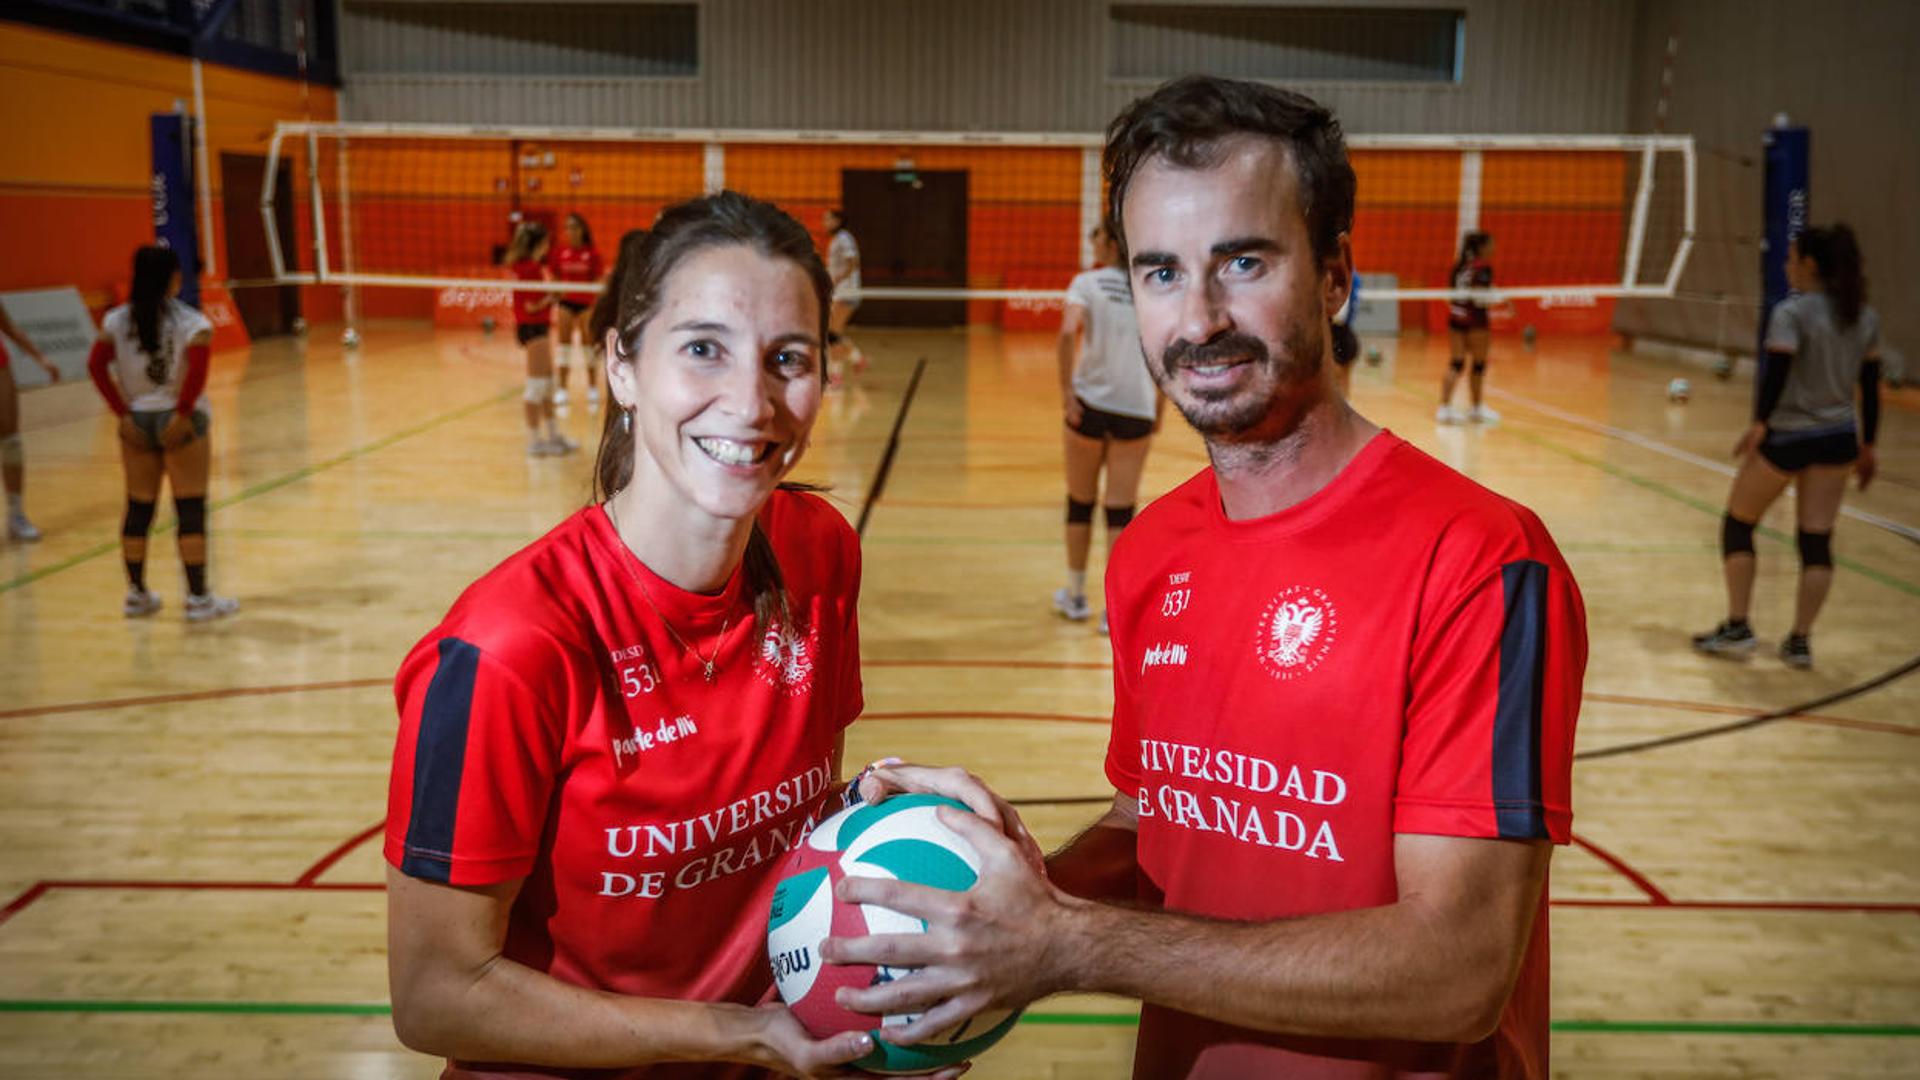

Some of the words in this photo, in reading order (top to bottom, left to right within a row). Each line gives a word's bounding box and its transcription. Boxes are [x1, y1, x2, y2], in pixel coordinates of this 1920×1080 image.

[1161, 589, 1192, 617] 1531
[656, 717, 678, 743] de
[604, 755, 832, 858] UNIVERSIDA
[1140, 739, 1347, 806] NIVERSIDAD
[599, 871, 665, 898] DE
[675, 799, 828, 890] GRANA
[1137, 786, 1155, 817] E
[1158, 784, 1345, 862] GRANADA
